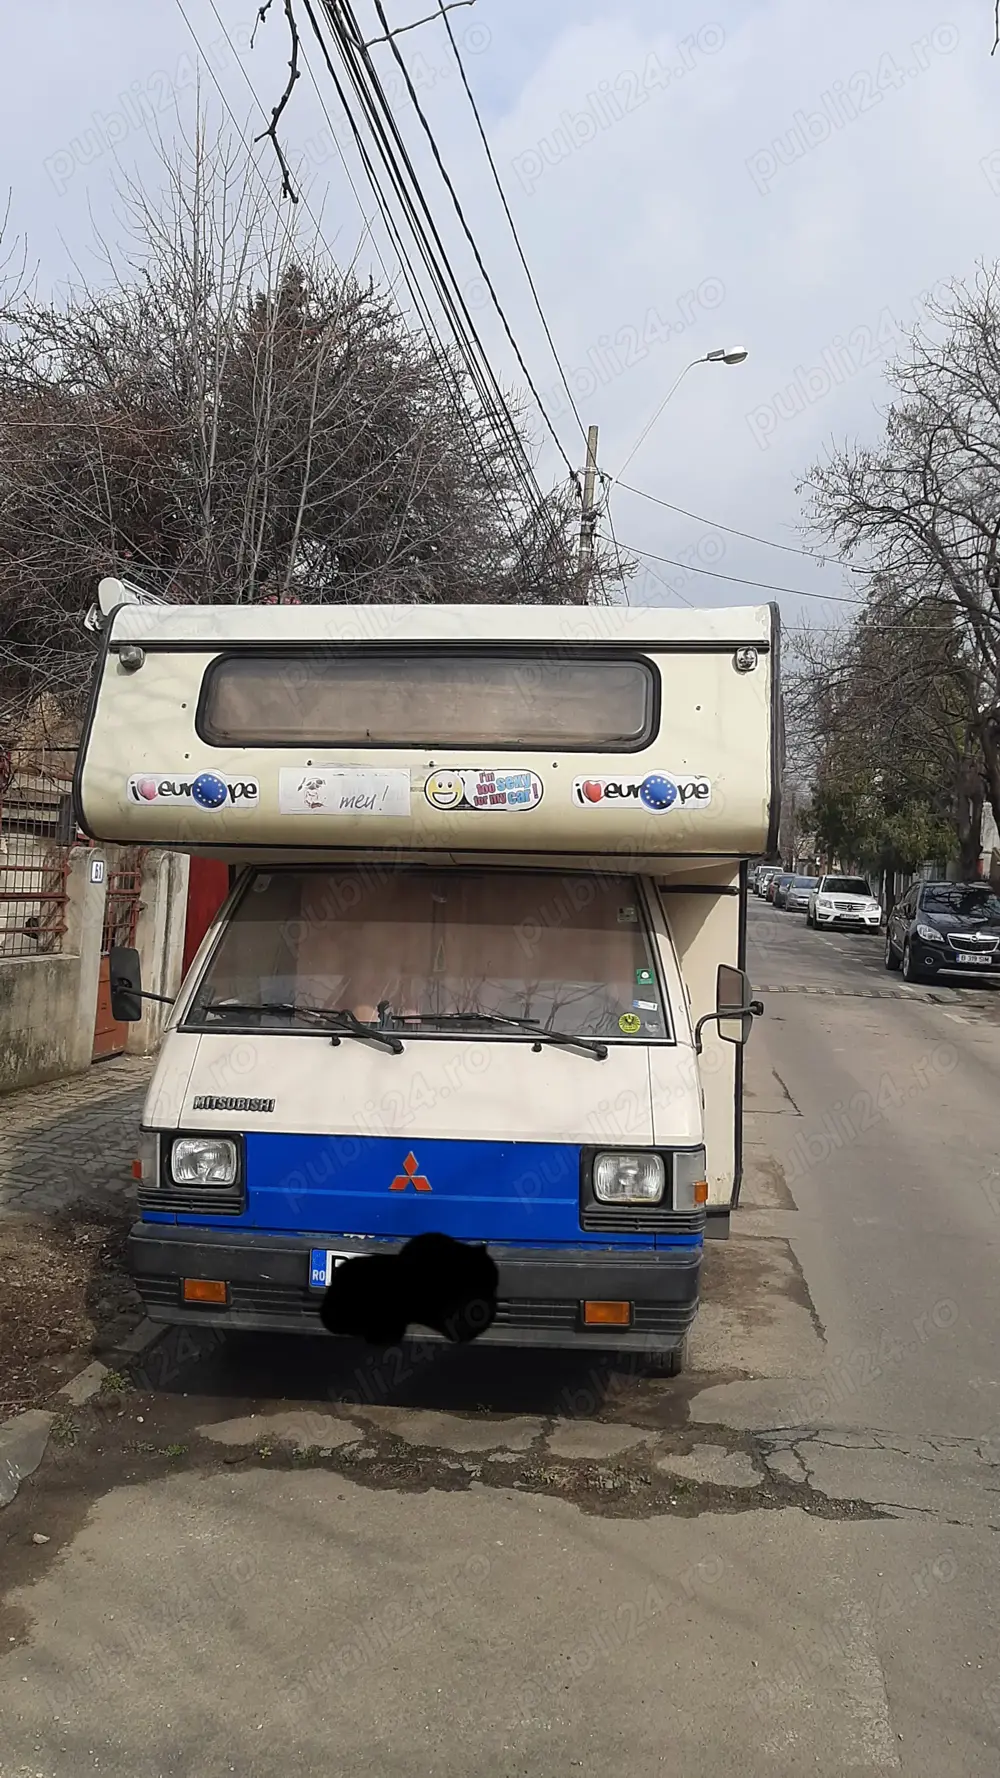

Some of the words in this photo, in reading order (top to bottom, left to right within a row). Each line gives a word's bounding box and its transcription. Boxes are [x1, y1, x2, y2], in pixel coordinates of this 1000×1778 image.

[496, 773, 531, 791] sexy
[489, 793, 507, 805] my
[193, 1095, 276, 1112] MITSUBISHI
[312, 1269, 325, 1281] RO
